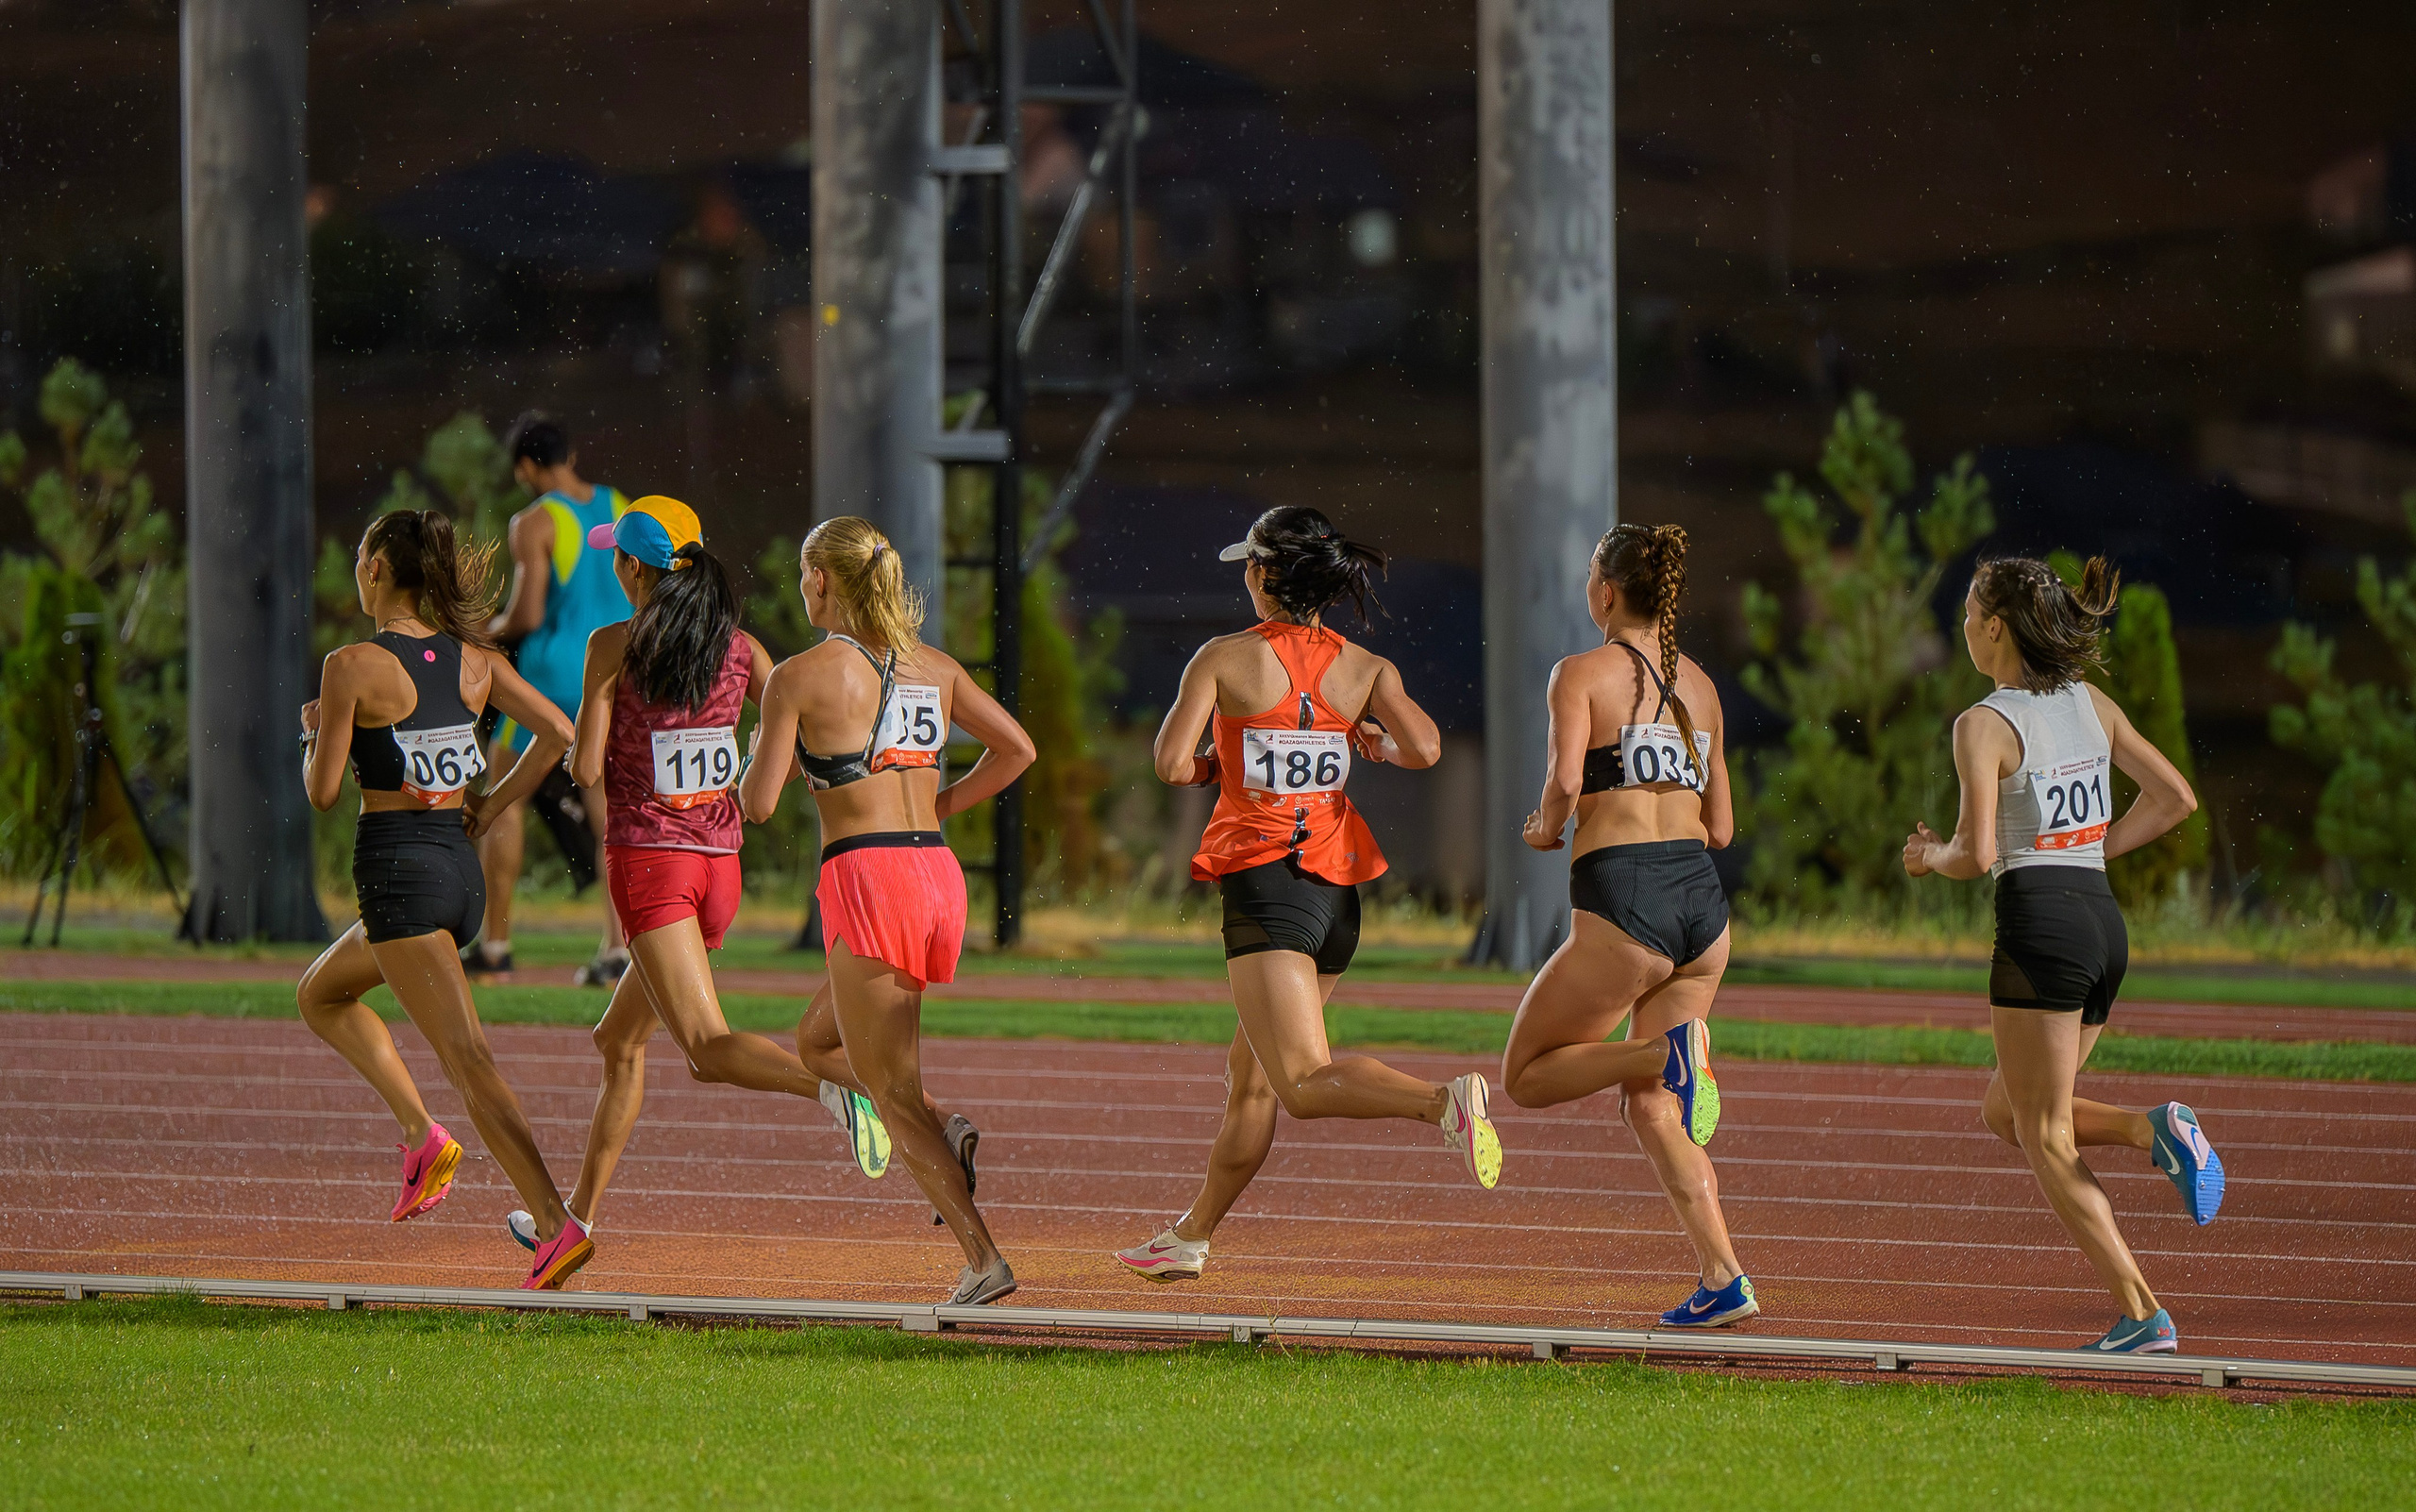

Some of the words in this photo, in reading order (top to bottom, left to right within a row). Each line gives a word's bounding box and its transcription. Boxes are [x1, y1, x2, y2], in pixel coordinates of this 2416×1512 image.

[411, 744, 481, 786] 063
[666, 747, 732, 789] 119
[1255, 750, 1341, 789] 186
[1633, 745, 1700, 789] 035
[2046, 774, 2106, 830] 201
